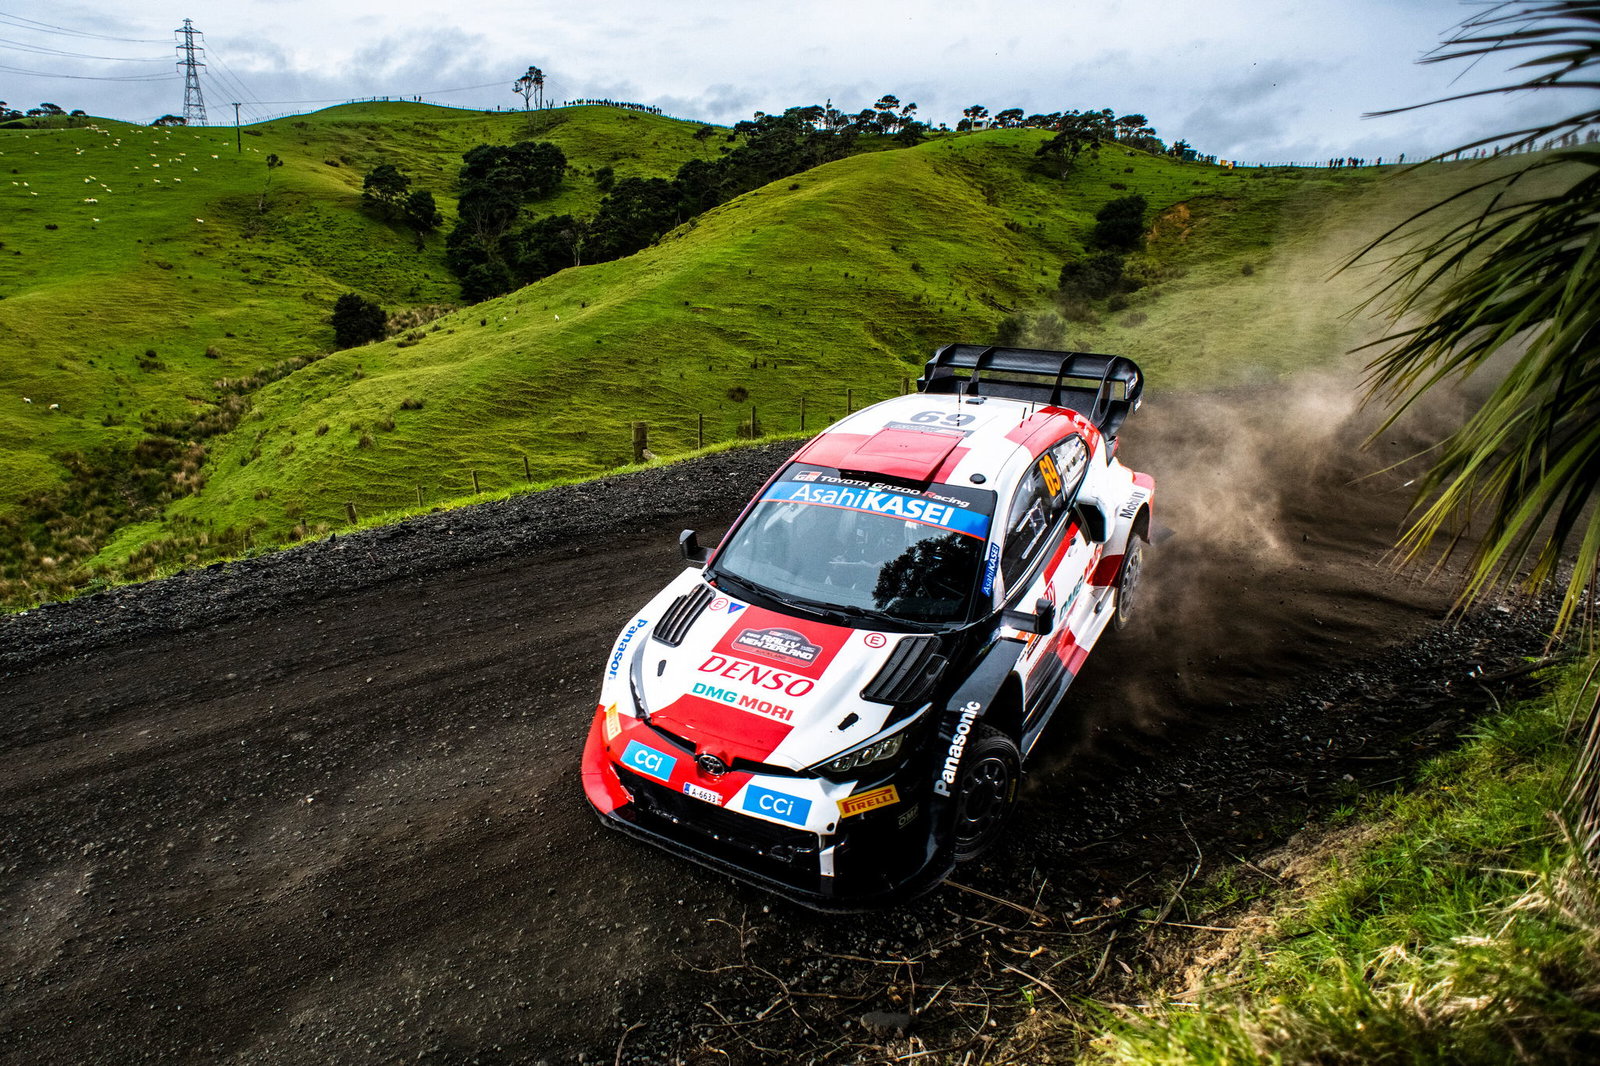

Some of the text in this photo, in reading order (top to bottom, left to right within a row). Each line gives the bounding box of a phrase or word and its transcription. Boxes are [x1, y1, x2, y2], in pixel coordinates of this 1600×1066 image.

[909, 410, 976, 427] 69
[820, 475, 870, 487] TOYOTA
[871, 481, 921, 496] GAZOO
[922, 490, 971, 508] Racing
[1039, 454, 1061, 497] 69
[789, 483, 955, 526] AsahiKASEI
[983, 544, 999, 595] AsahiKASEI
[739, 636, 764, 648] NEW
[760, 635, 801, 649] RALLY
[698, 655, 815, 697] DENSO
[692, 682, 794, 722] DMG MORI
[934, 700, 981, 797] Panasonic
[691, 788, 717, 803] A-6633
[842, 788, 895, 814] PIRELLI
